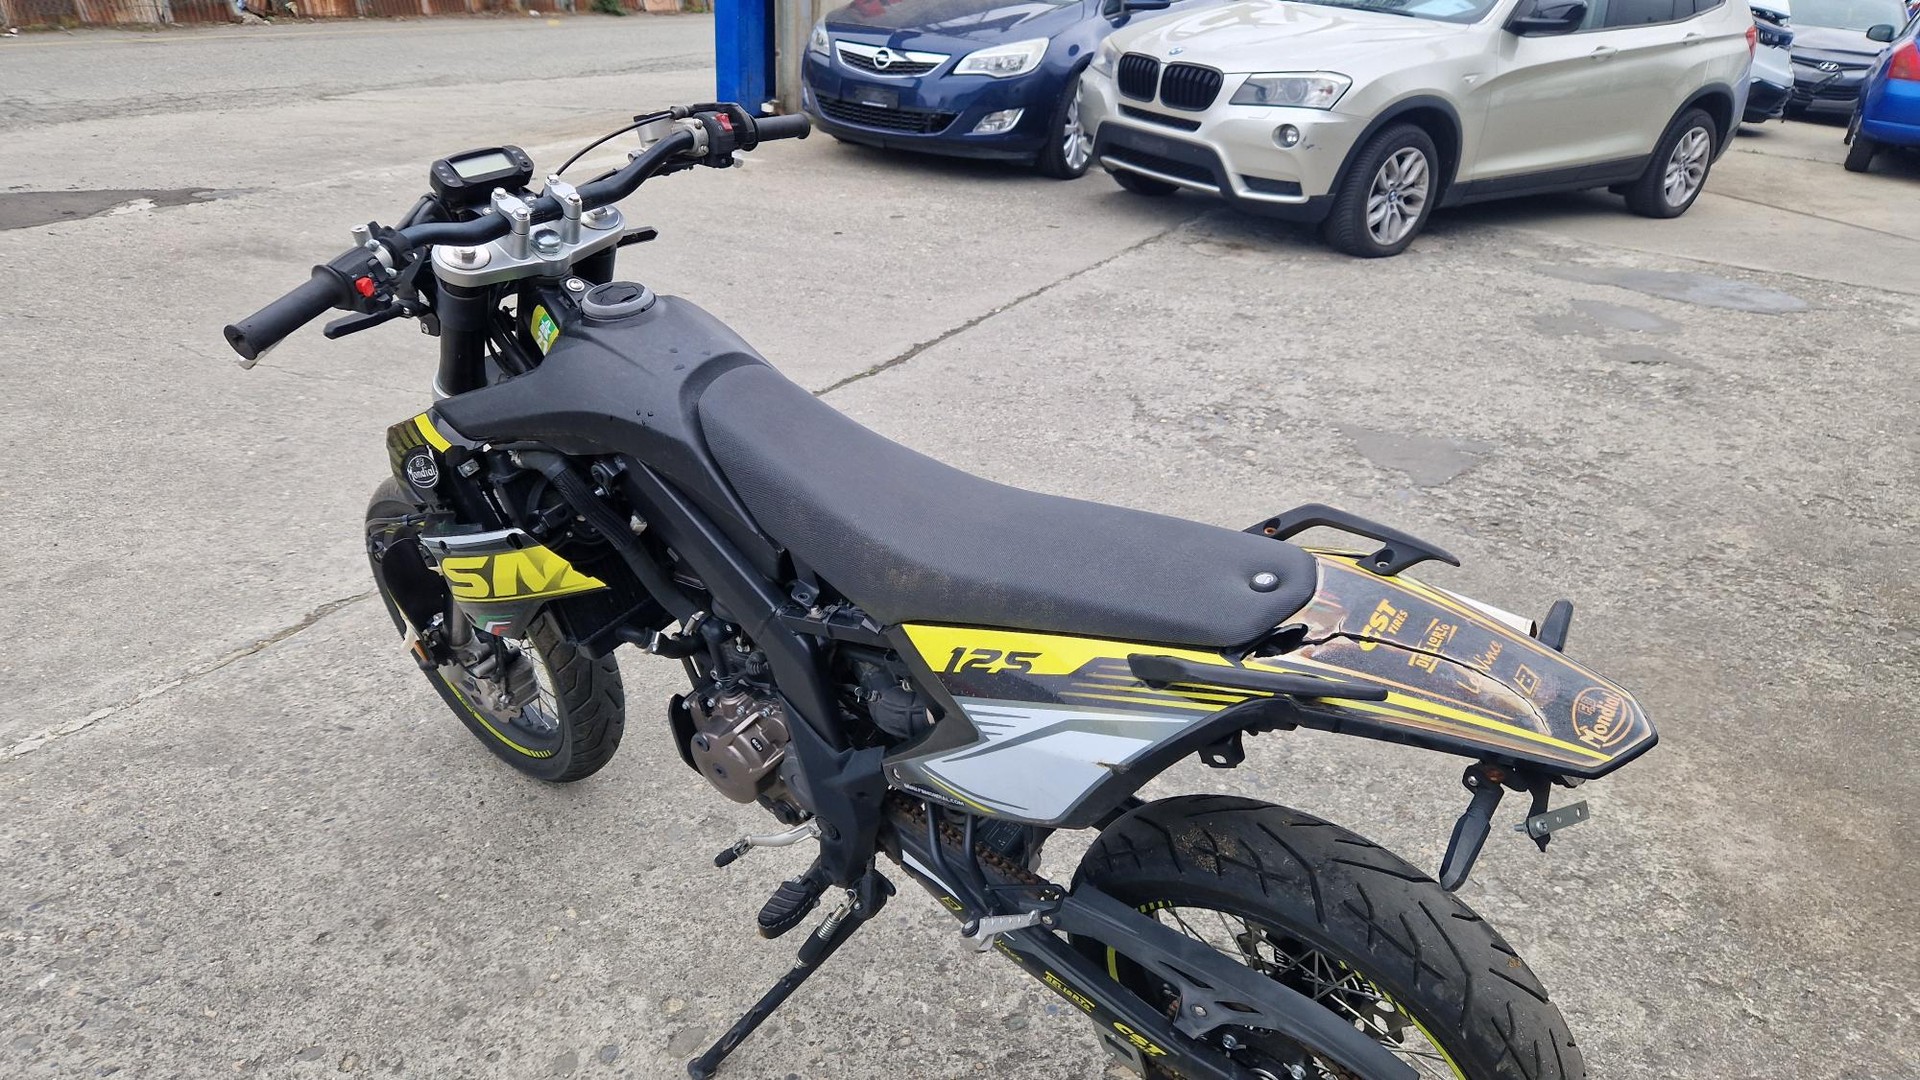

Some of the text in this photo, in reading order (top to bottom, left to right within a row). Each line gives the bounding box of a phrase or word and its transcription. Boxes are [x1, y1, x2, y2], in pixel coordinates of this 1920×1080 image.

[442, 545, 580, 598] SM
[1359, 598, 1398, 651] CST
[1388, 610, 1408, 634] TIRES
[944, 646, 1043, 675] 125
[1578, 692, 1621, 750] Mondial
[1113, 1021, 1168, 1056] CST
